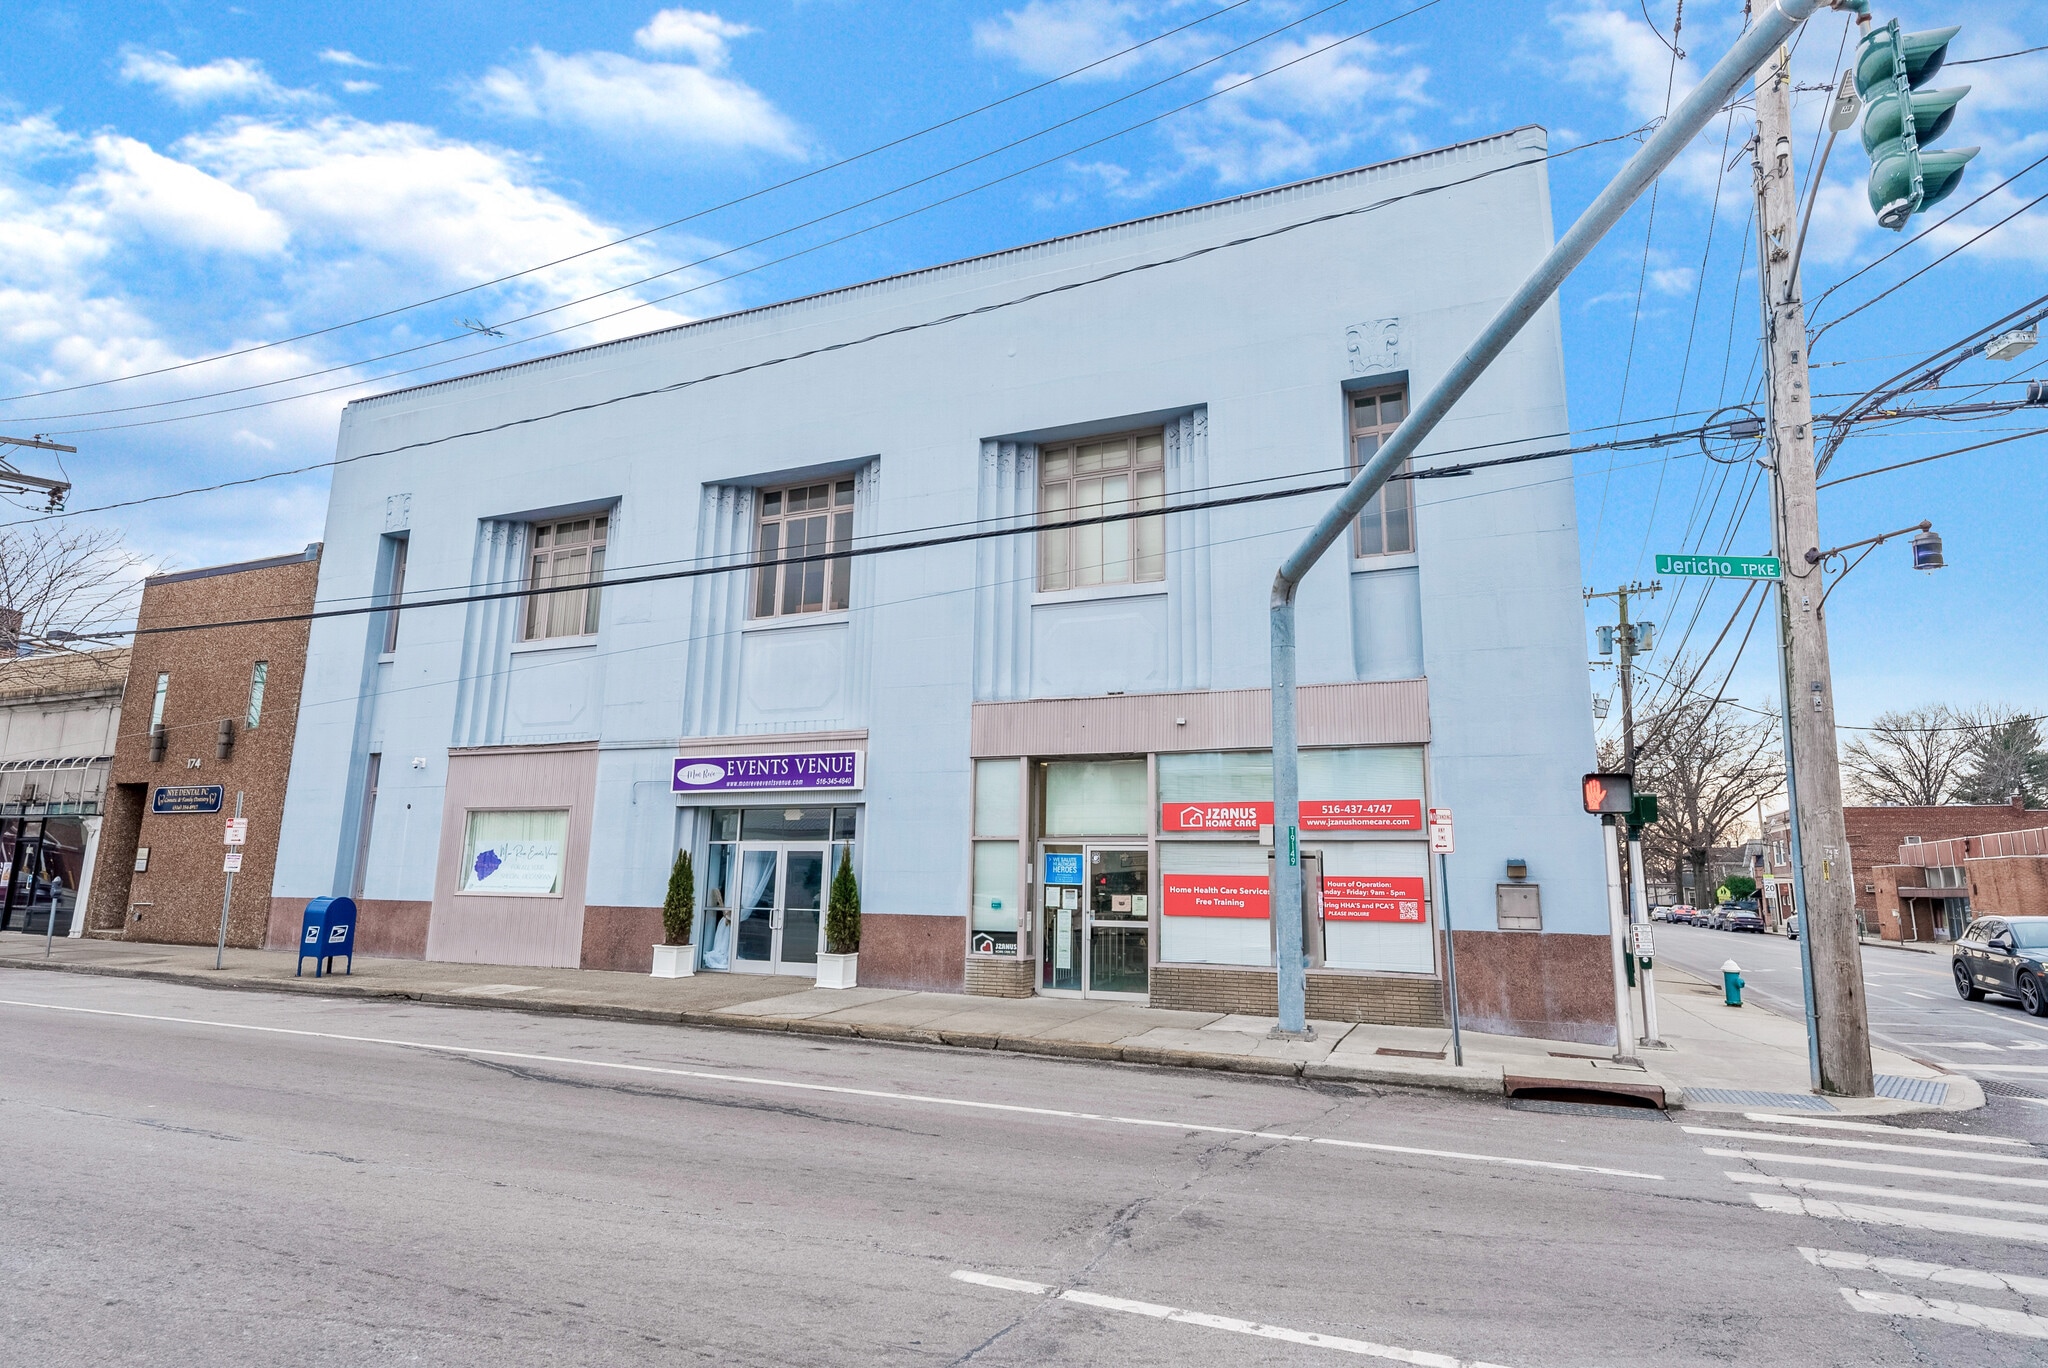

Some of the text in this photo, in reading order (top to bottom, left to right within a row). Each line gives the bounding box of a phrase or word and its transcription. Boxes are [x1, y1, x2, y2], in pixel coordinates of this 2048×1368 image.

[1661, 556, 1776, 576] Jericho TPKE
[187, 758, 202, 769] 174
[727, 756, 853, 776] EVENTS VENUE
[166, 787, 210, 797] NYE DENTAL PC
[1205, 807, 1257, 819] JZANUS
[1321, 804, 1393, 814] 516-437-4747
[1205, 819, 1257, 828] HOME CARE
[1306, 818, 1410, 828] www.jzanushomecare.com
[1356, 881, 1392, 889] Operation:
[1765, 884, 1775, 892] 20
[1169, 886, 1192, 894] Home
[1193, 886, 1219, 895] Health
[1220, 887, 1238, 895] Care
[1346, 889, 1369, 897] Friday:
[1390, 889, 1406, 897] 5pm
[1195, 897, 1245, 908] Free Training
[1324, 901, 1339, 910] iring
[1375, 902, 1395, 910] PCA'S
